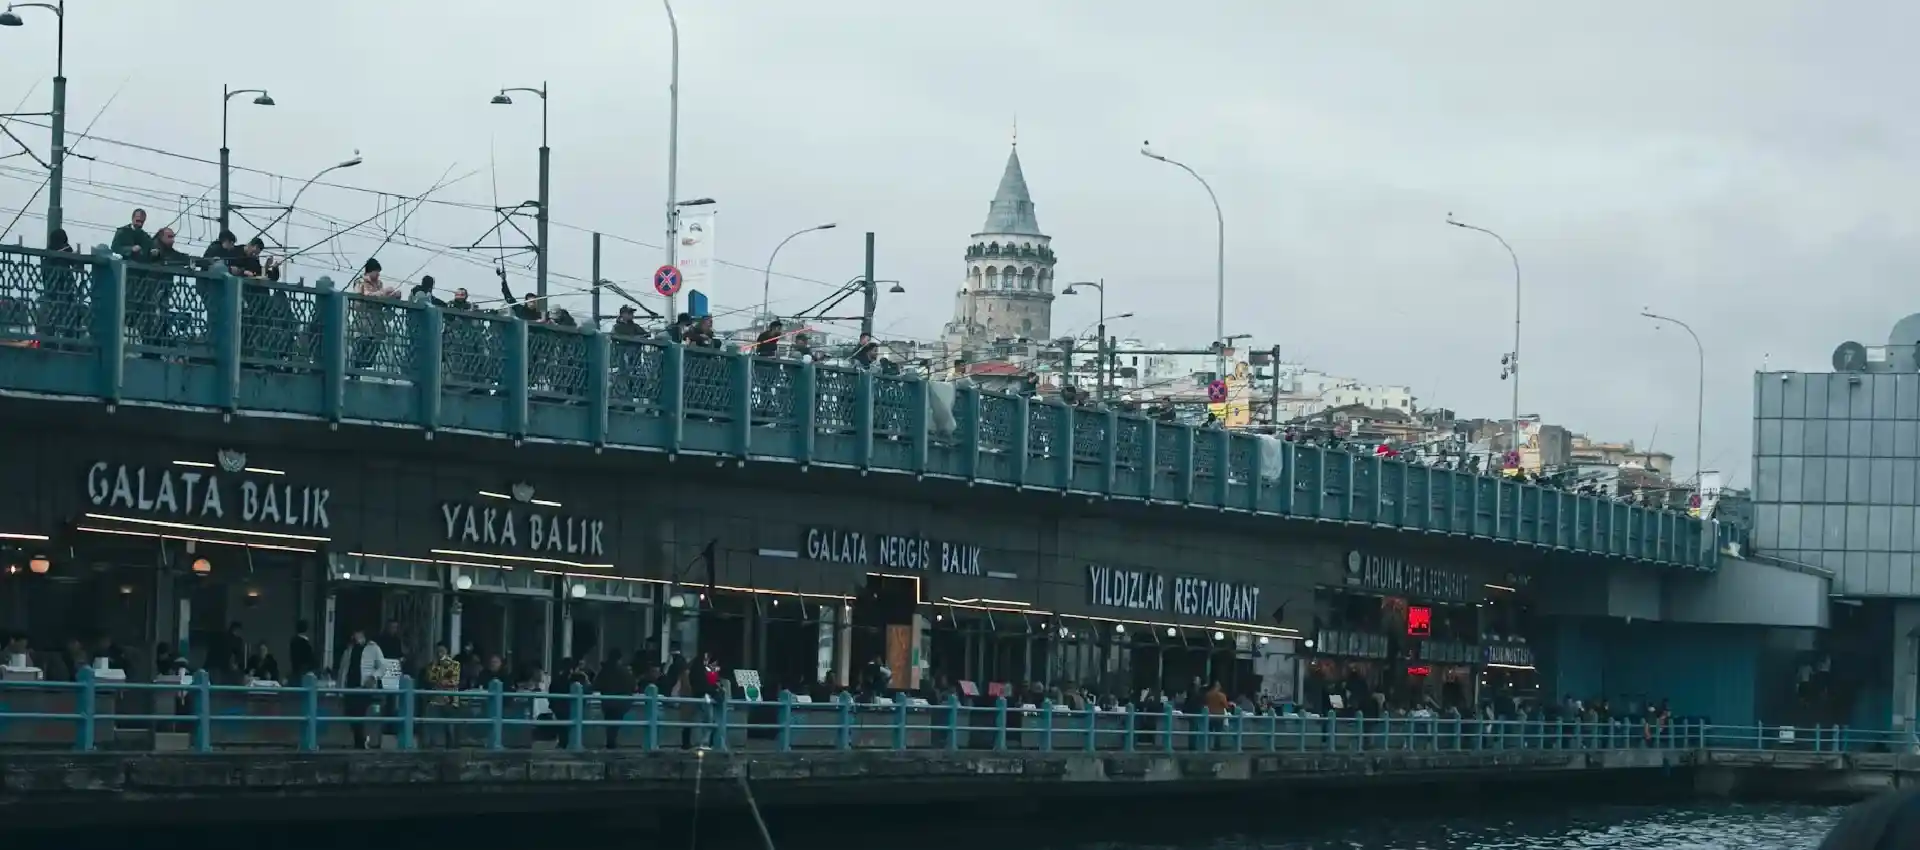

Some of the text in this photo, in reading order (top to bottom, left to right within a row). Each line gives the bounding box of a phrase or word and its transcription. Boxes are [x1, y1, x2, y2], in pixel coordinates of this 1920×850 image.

[88, 461, 330, 529] GALATA BALIK
[442, 503, 604, 556] YAKA BALIK
[807, 528, 868, 565] GALATA
[941, 542, 982, 576] BALIK
[1090, 565, 1260, 621] YILDIZLAR RESTAURANT
[1364, 554, 1402, 589] ARUNA
